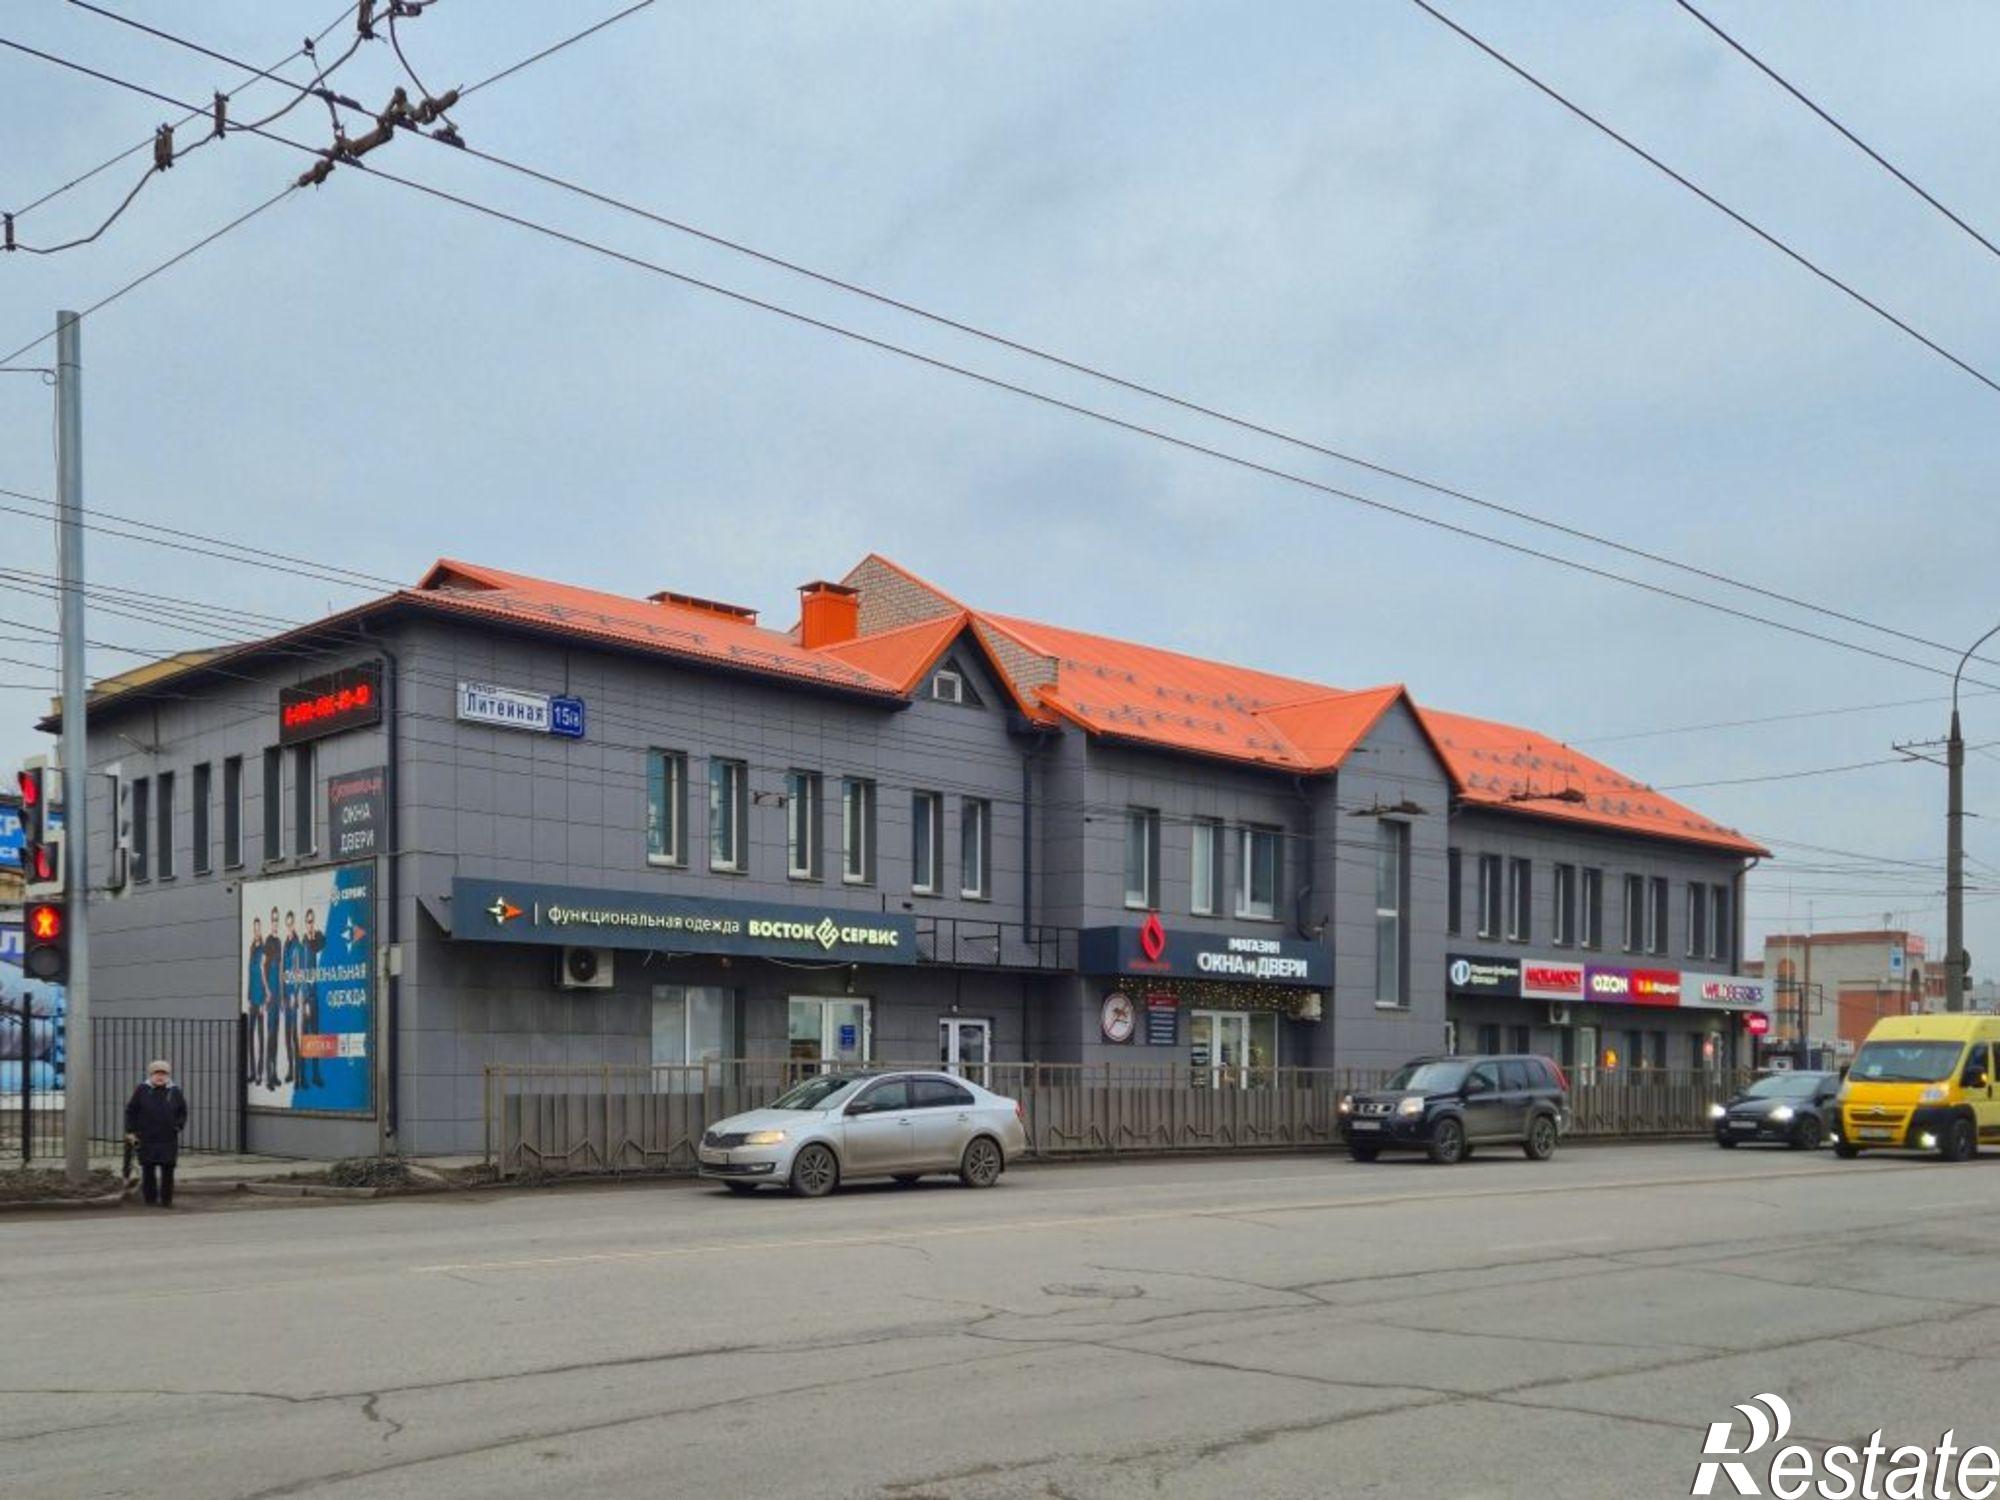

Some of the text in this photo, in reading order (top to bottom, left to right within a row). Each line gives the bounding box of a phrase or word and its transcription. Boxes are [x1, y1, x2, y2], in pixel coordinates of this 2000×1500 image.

[467, 692, 545, 722] Литейная
[342, 802, 371, 824] ОКНА
[340, 829, 374, 853] ДВЕРИ
[547, 905, 899, 947] функциональная одежда ВОСТОК СЕРВИС
[1229, 937, 1281, 954] МАГАЗИН
[1196, 951, 1245, 974] ОКНА
[1256, 958, 1308, 979] ДВЕРИ
[1592, 974, 1628, 993] OZON
[327, 988, 367, 1009] ОДЕЖДА
